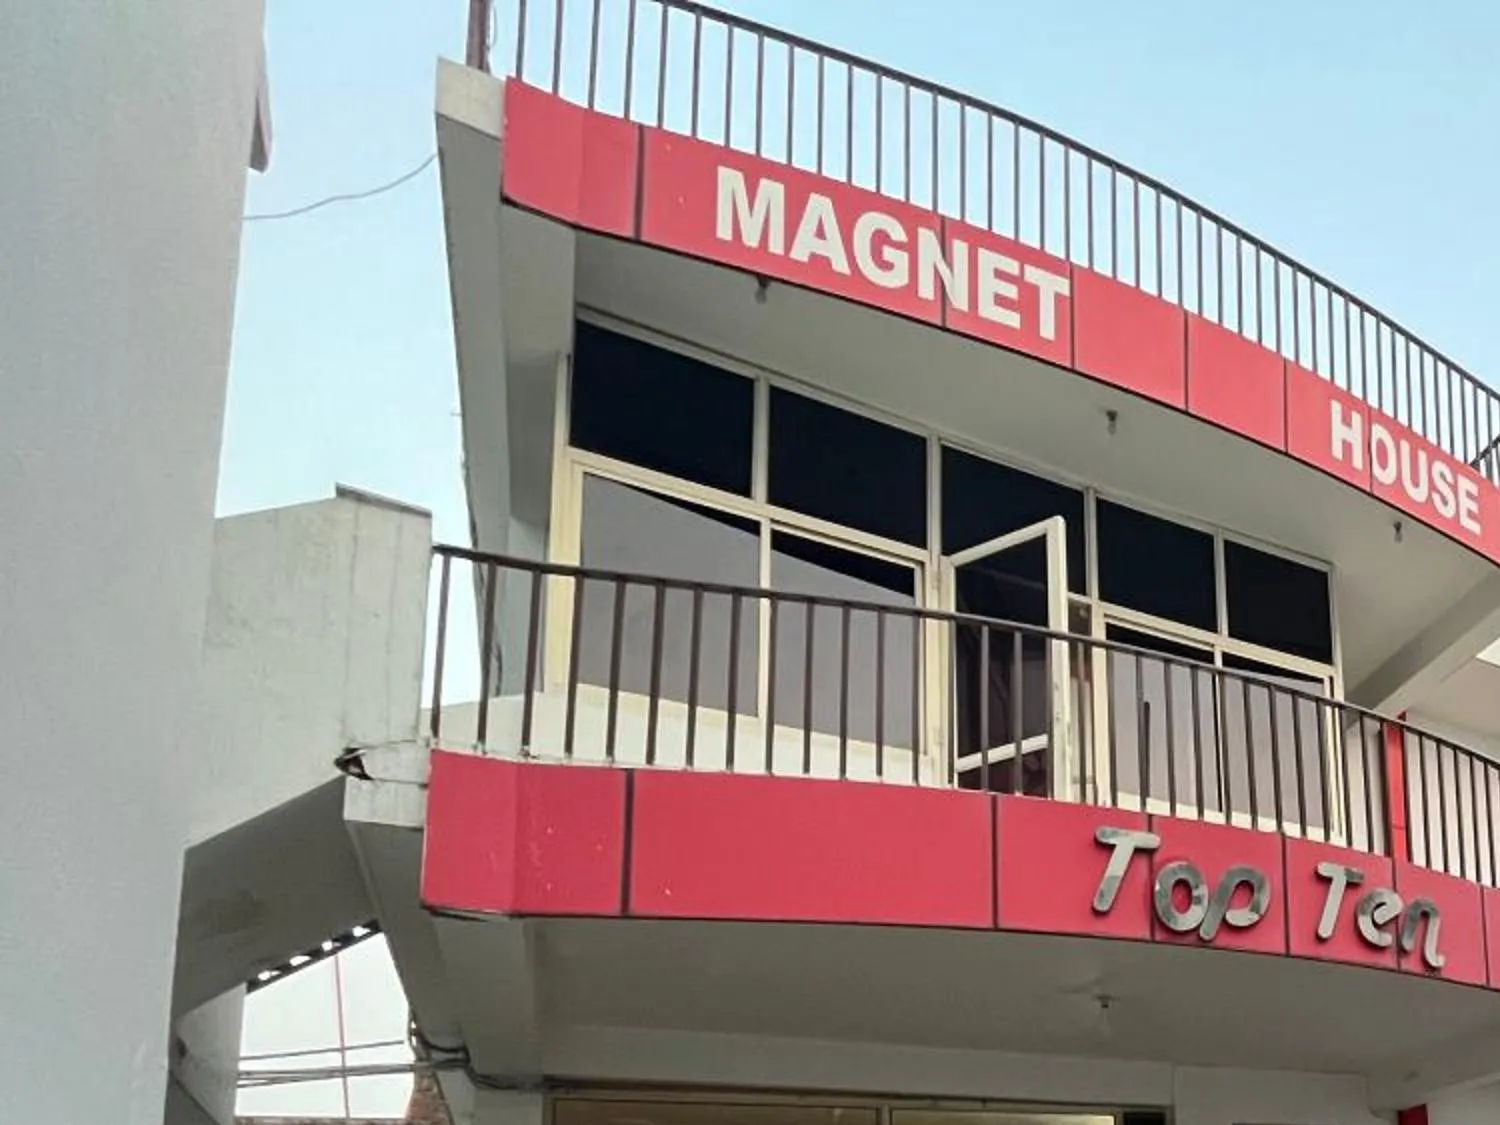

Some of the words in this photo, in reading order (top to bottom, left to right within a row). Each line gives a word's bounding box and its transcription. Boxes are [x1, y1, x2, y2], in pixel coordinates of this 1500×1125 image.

[715, 164, 1071, 341] MAGNET
[1330, 399, 1481, 535] HOUSE
[1091, 824, 1271, 942] Top
[1314, 860, 1447, 969] Ten
